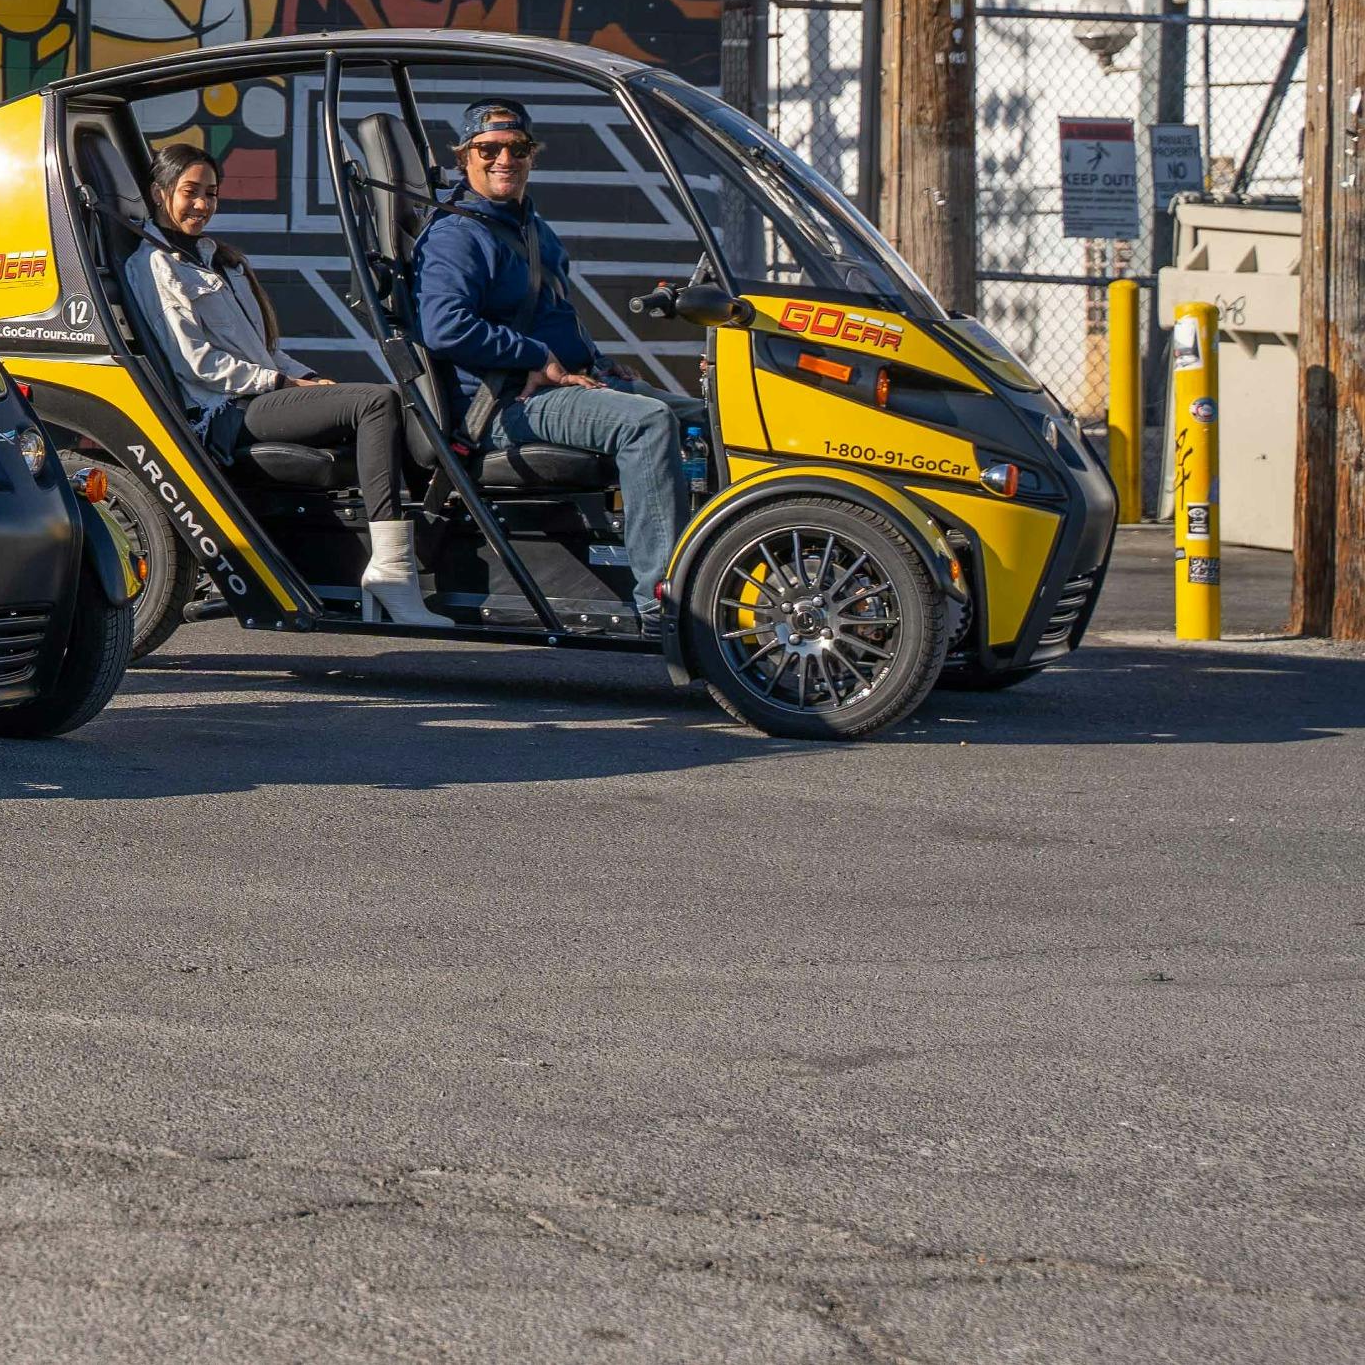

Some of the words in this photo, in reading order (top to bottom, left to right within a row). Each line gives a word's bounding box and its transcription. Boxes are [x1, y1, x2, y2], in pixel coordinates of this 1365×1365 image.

[1064, 173, 1099, 186] KEEP
[1166, 161, 1188, 180] NO
[67, 300, 89, 326] 12
[823, 440, 970, 477] 1-800-91-GoCar
[126, 443, 247, 595] ARCIMOTO
